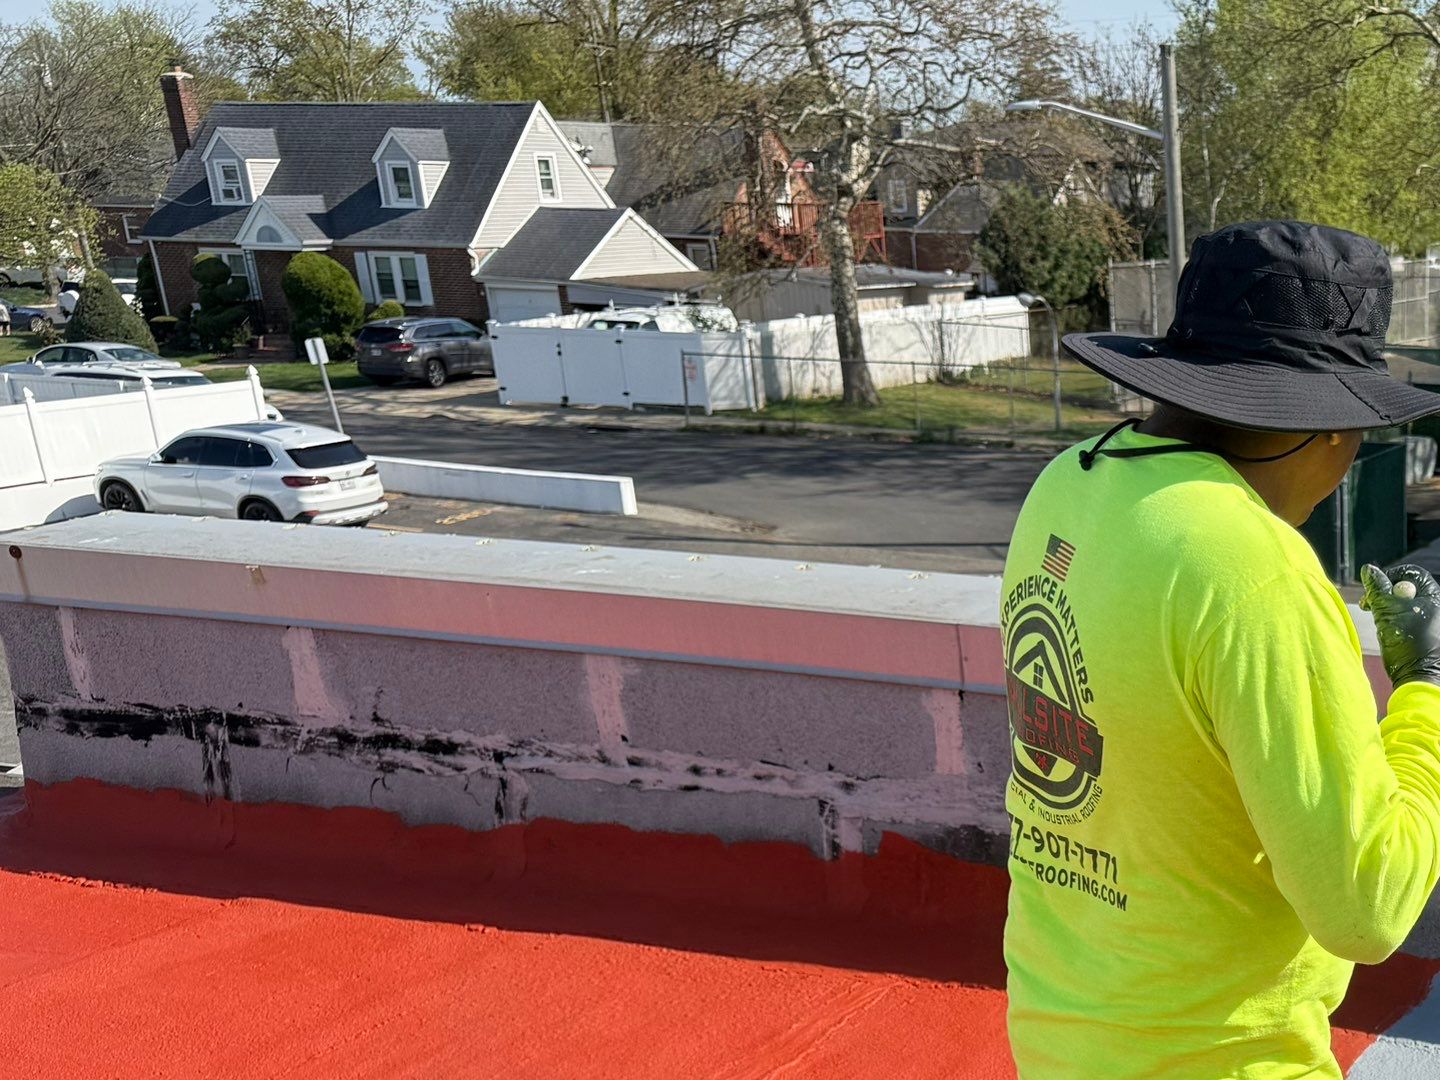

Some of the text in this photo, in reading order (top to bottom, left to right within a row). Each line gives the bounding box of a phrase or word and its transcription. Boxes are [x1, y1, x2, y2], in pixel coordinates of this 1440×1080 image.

[1056, 589, 1093, 704] MATTERS
[1028, 799, 1036, 812] &
[1038, 807, 1082, 825] INDUSTRIAL
[1079, 783, 1103, 820] ROOFING
[1010, 814, 1118, 884] 7-907-7771
